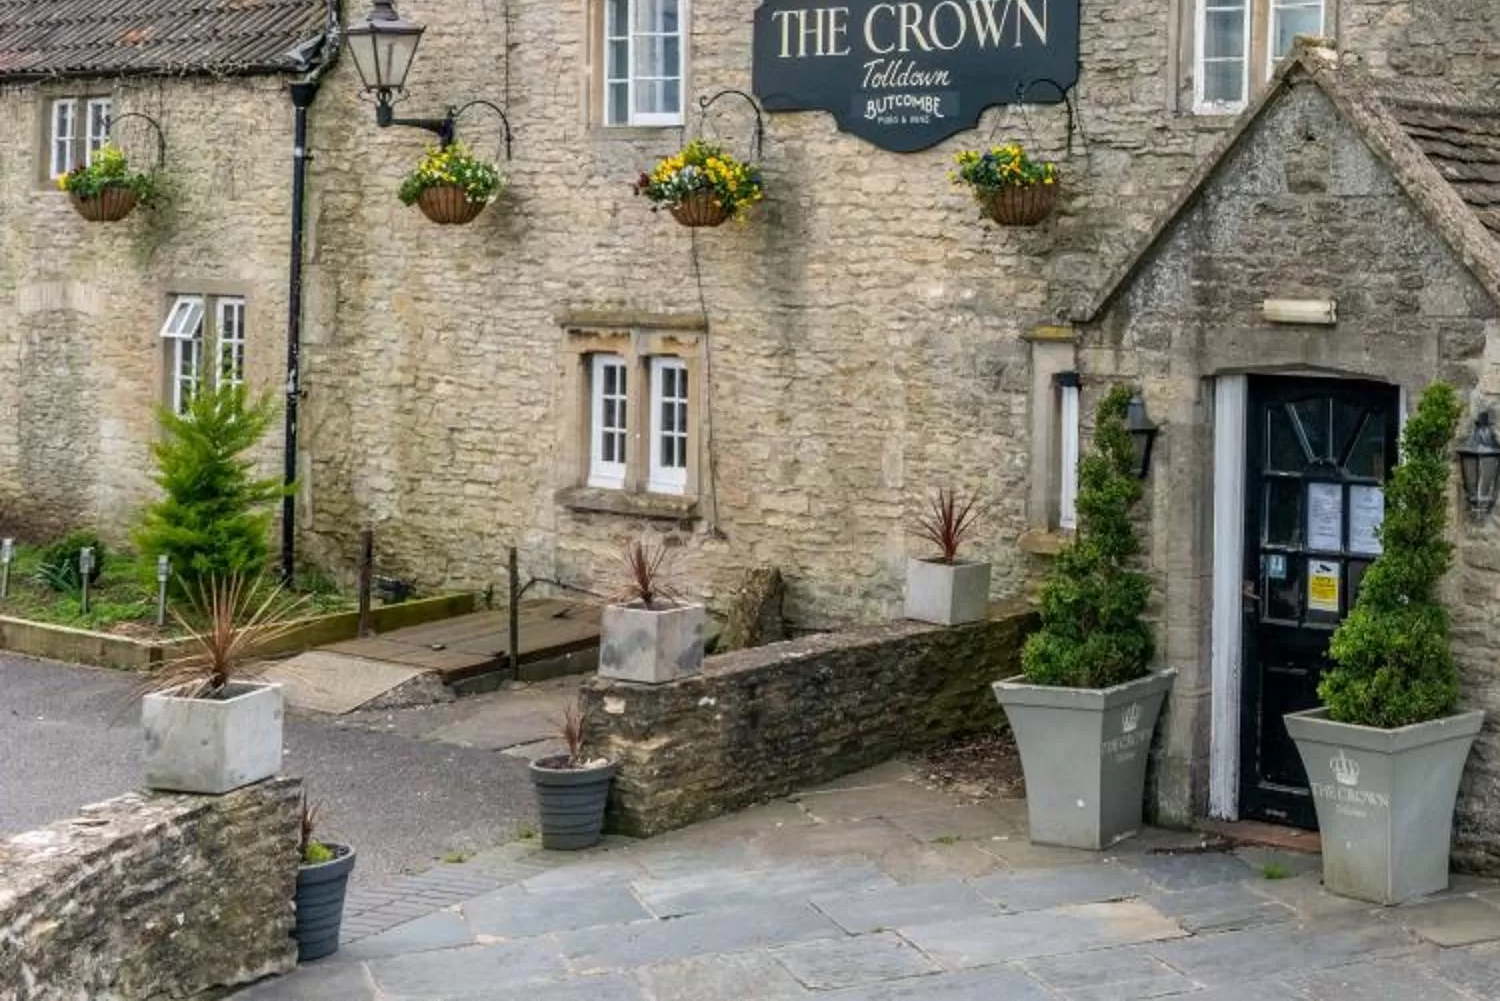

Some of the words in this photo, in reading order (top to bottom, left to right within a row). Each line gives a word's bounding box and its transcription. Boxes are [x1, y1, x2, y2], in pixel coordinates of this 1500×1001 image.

[771, 6, 851, 58] THE
[861, 58, 951, 89] Tolldown
[863, 94, 945, 120] BUTCOMBE
